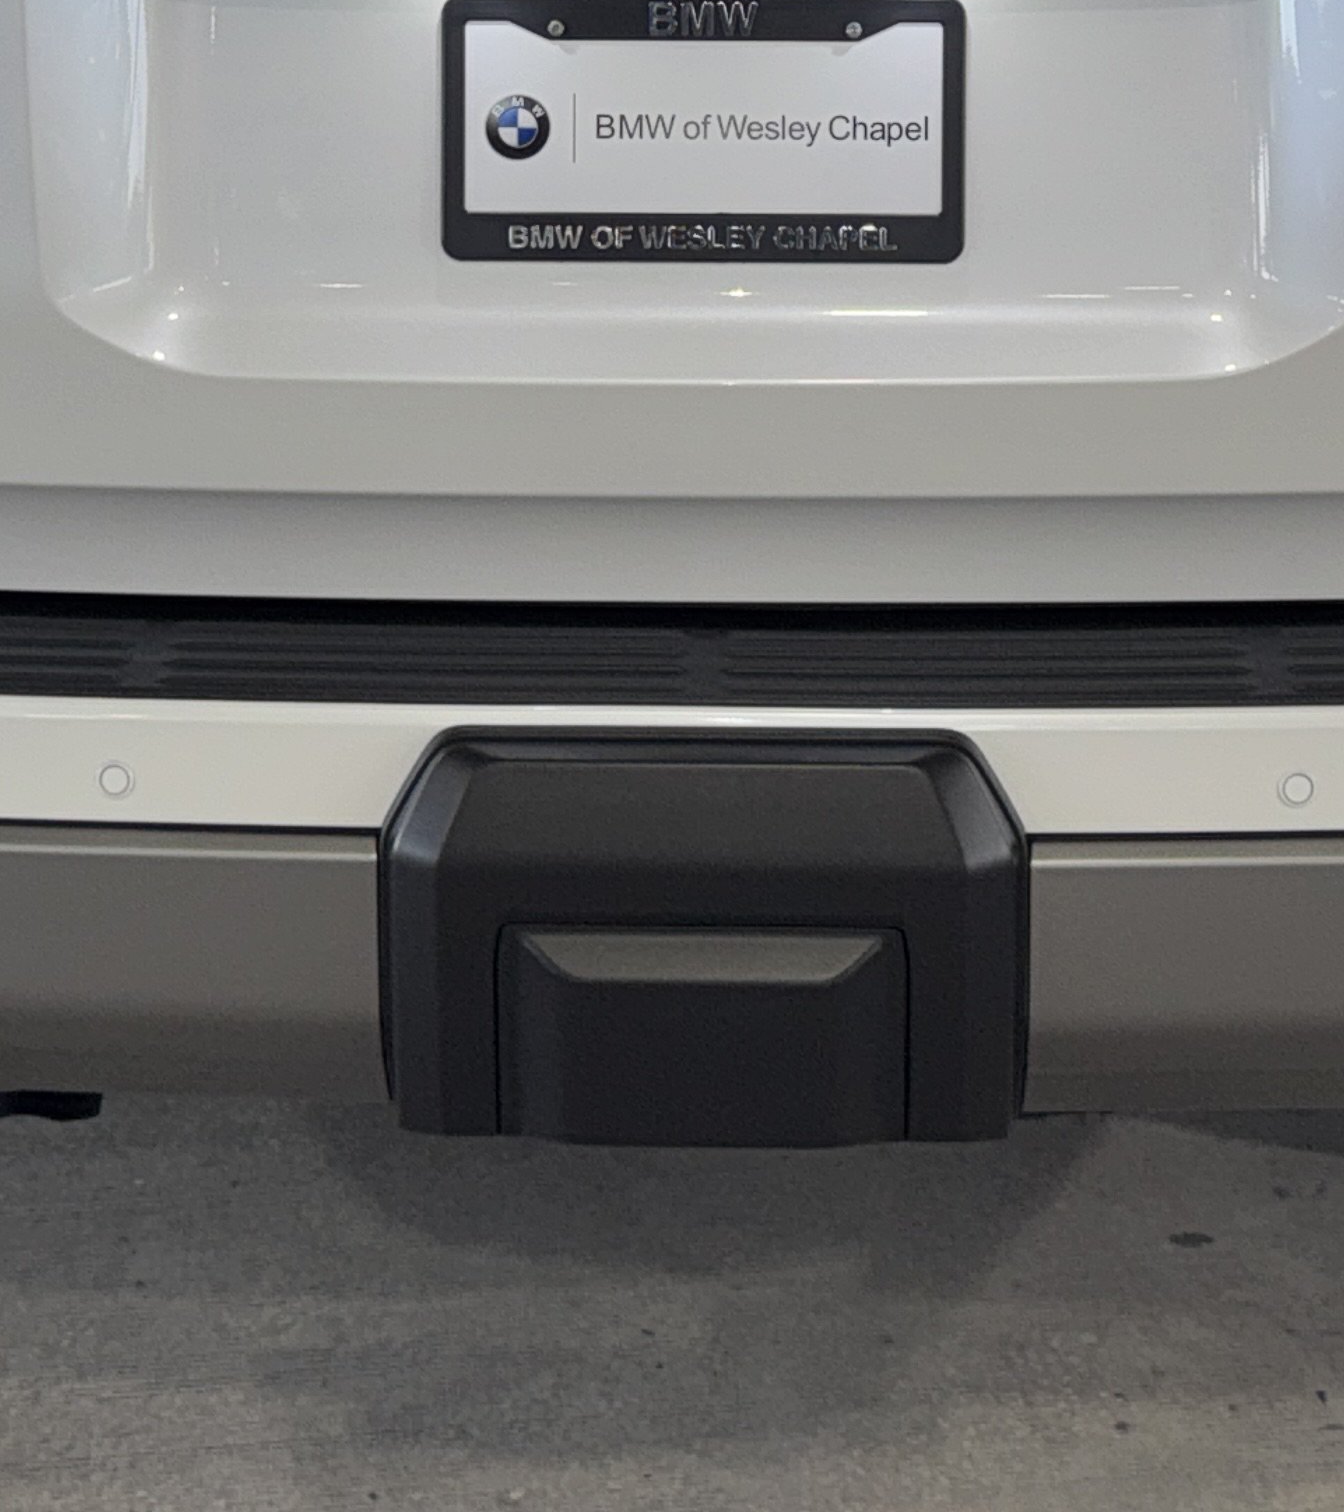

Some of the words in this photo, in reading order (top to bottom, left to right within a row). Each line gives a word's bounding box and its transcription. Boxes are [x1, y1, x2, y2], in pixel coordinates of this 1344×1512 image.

[648, 0, 759, 37] BMW
[595, 113, 676, 140] BMW
[683, 113, 712, 141] of
[717, 114, 821, 148] Wesley
[828, 114, 929, 148] Chapel
[508, 224, 584, 250] BMW
[591, 225, 633, 249] OF
[639, 224, 766, 251] WESLEY
[773, 224, 898, 251] CHAPEL
